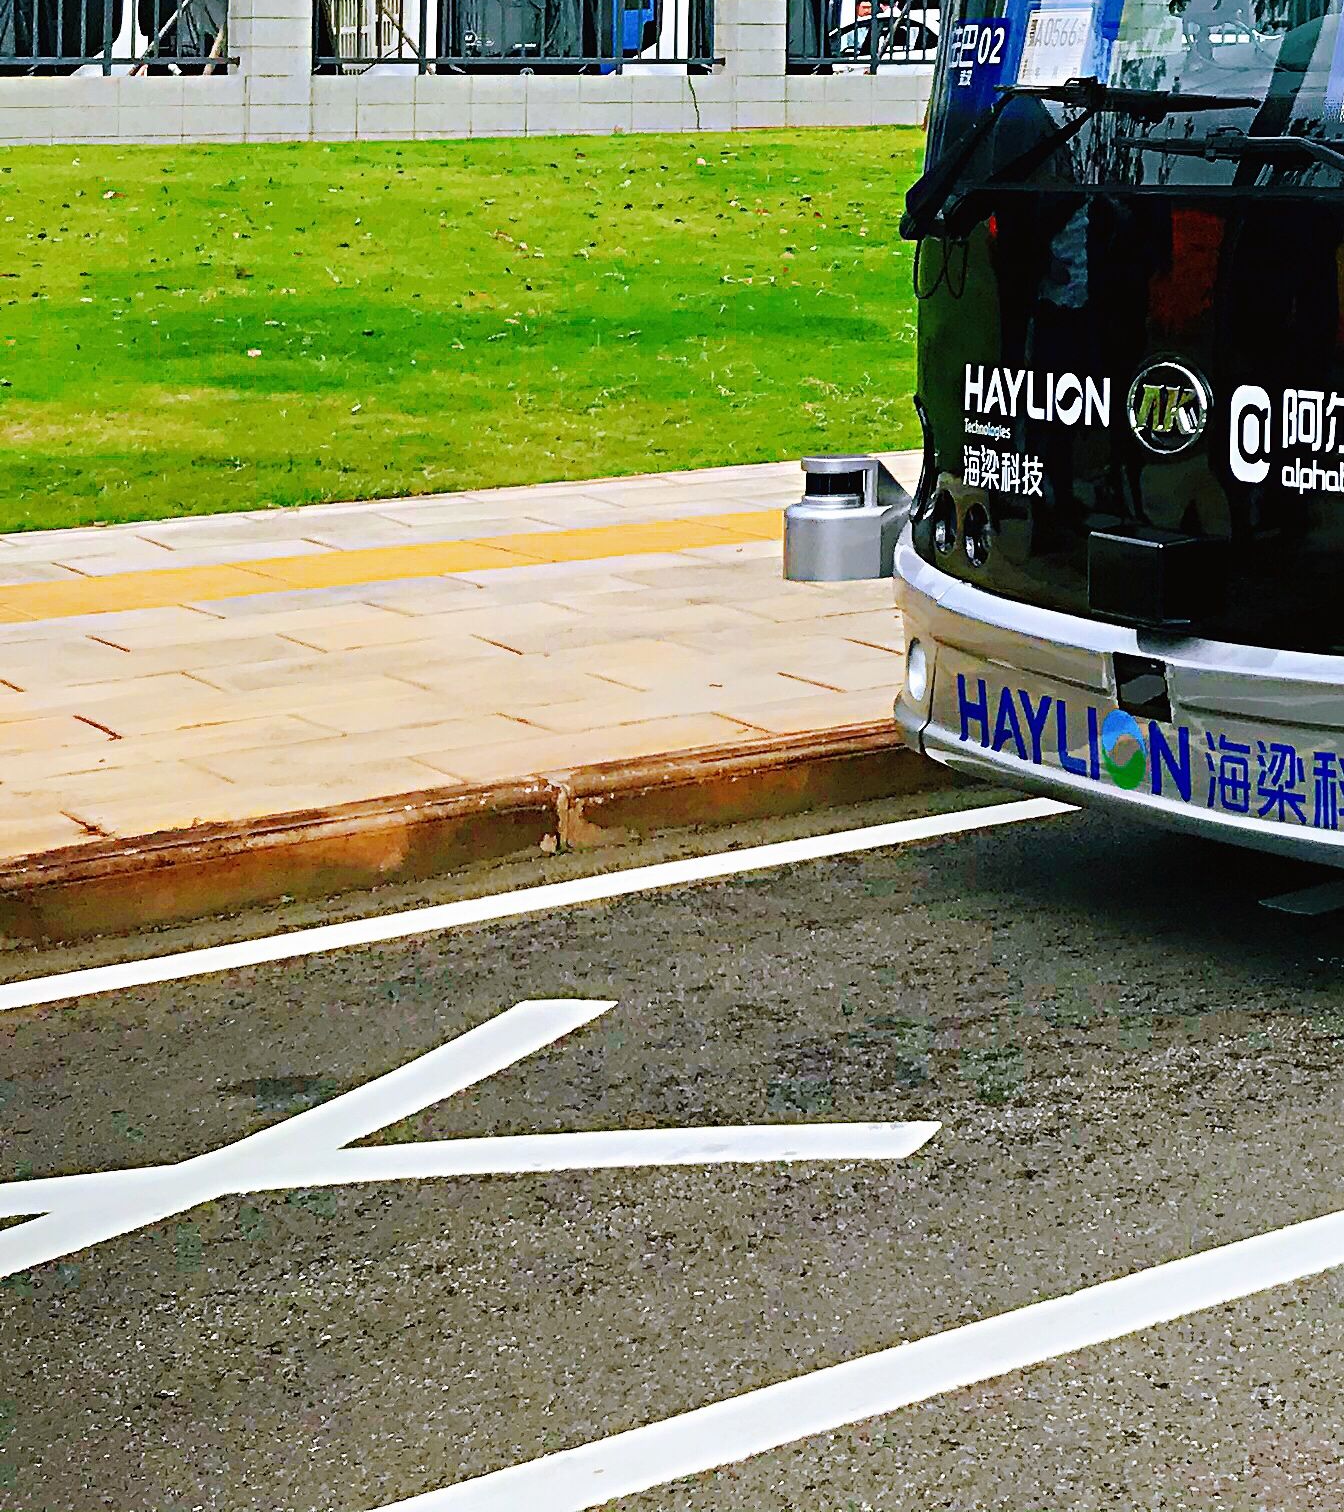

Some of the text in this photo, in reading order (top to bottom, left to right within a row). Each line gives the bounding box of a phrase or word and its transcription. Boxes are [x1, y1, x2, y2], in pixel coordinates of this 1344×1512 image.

[964, 363, 1111, 428] HAYLION
[964, 417, 1011, 441] Technologies
[962, 444, 1044, 498] 海梁科技
[957, 673, 1192, 803] HAYLION
